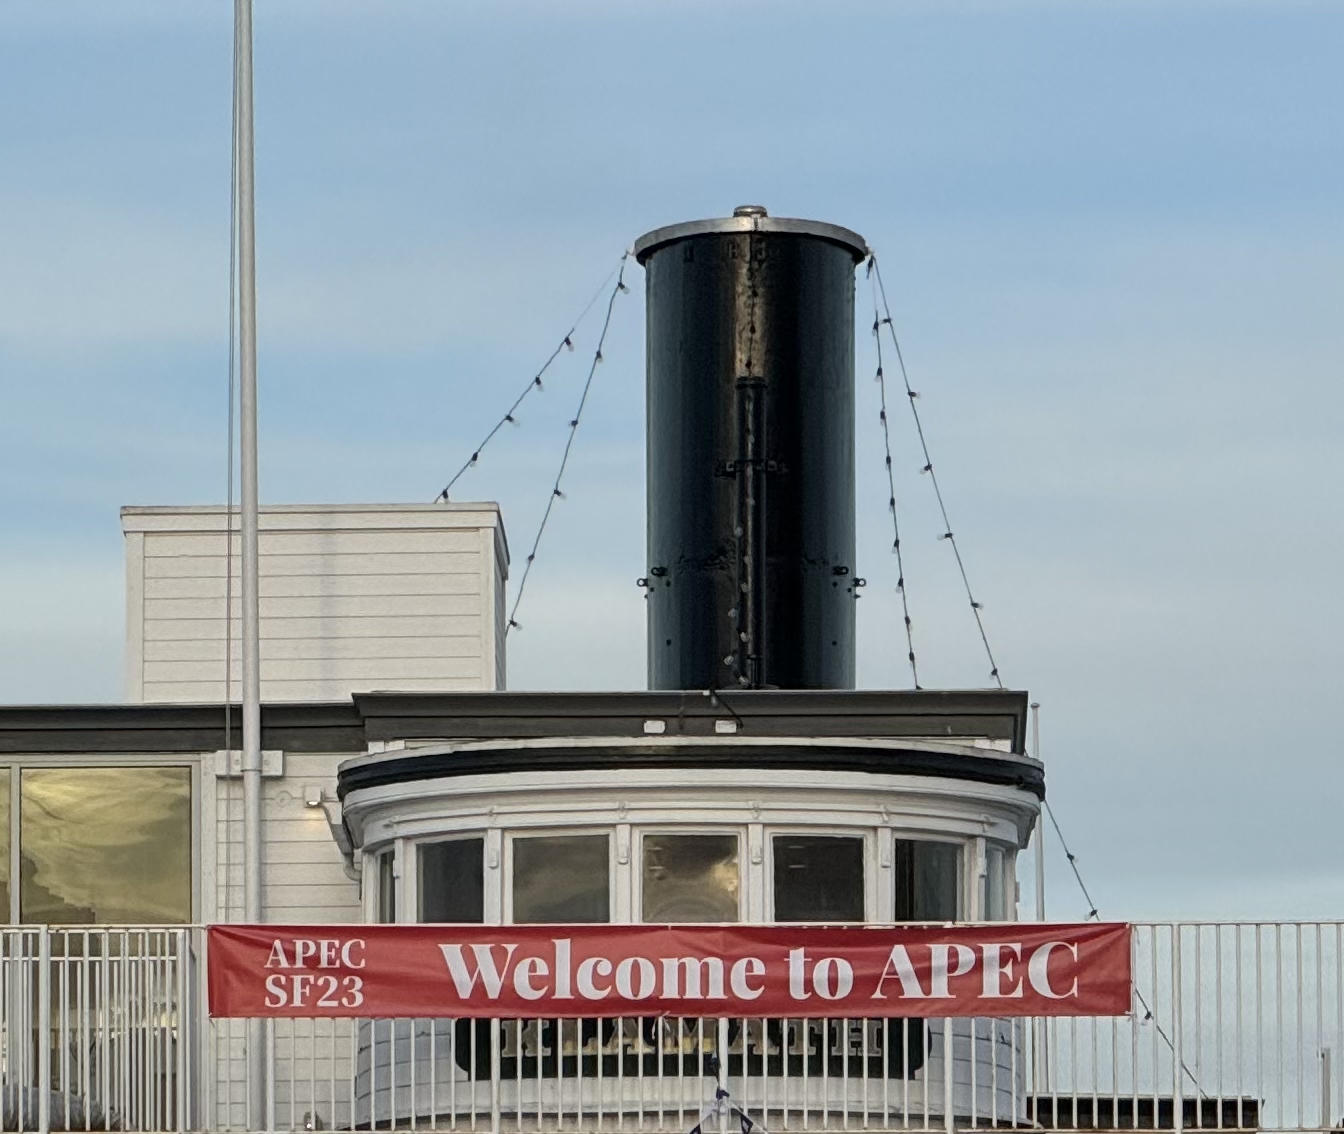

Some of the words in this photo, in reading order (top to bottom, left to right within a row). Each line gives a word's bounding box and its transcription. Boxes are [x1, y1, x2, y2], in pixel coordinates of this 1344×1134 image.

[263, 938, 366, 970] APEC
[437, 937, 767, 1001] Welcome
[783, 946, 855, 1001] to
[870, 941, 1079, 1000] APEC
[264, 973, 365, 1008] SF23
[501, 1017, 882, 1058] KLAMATH
